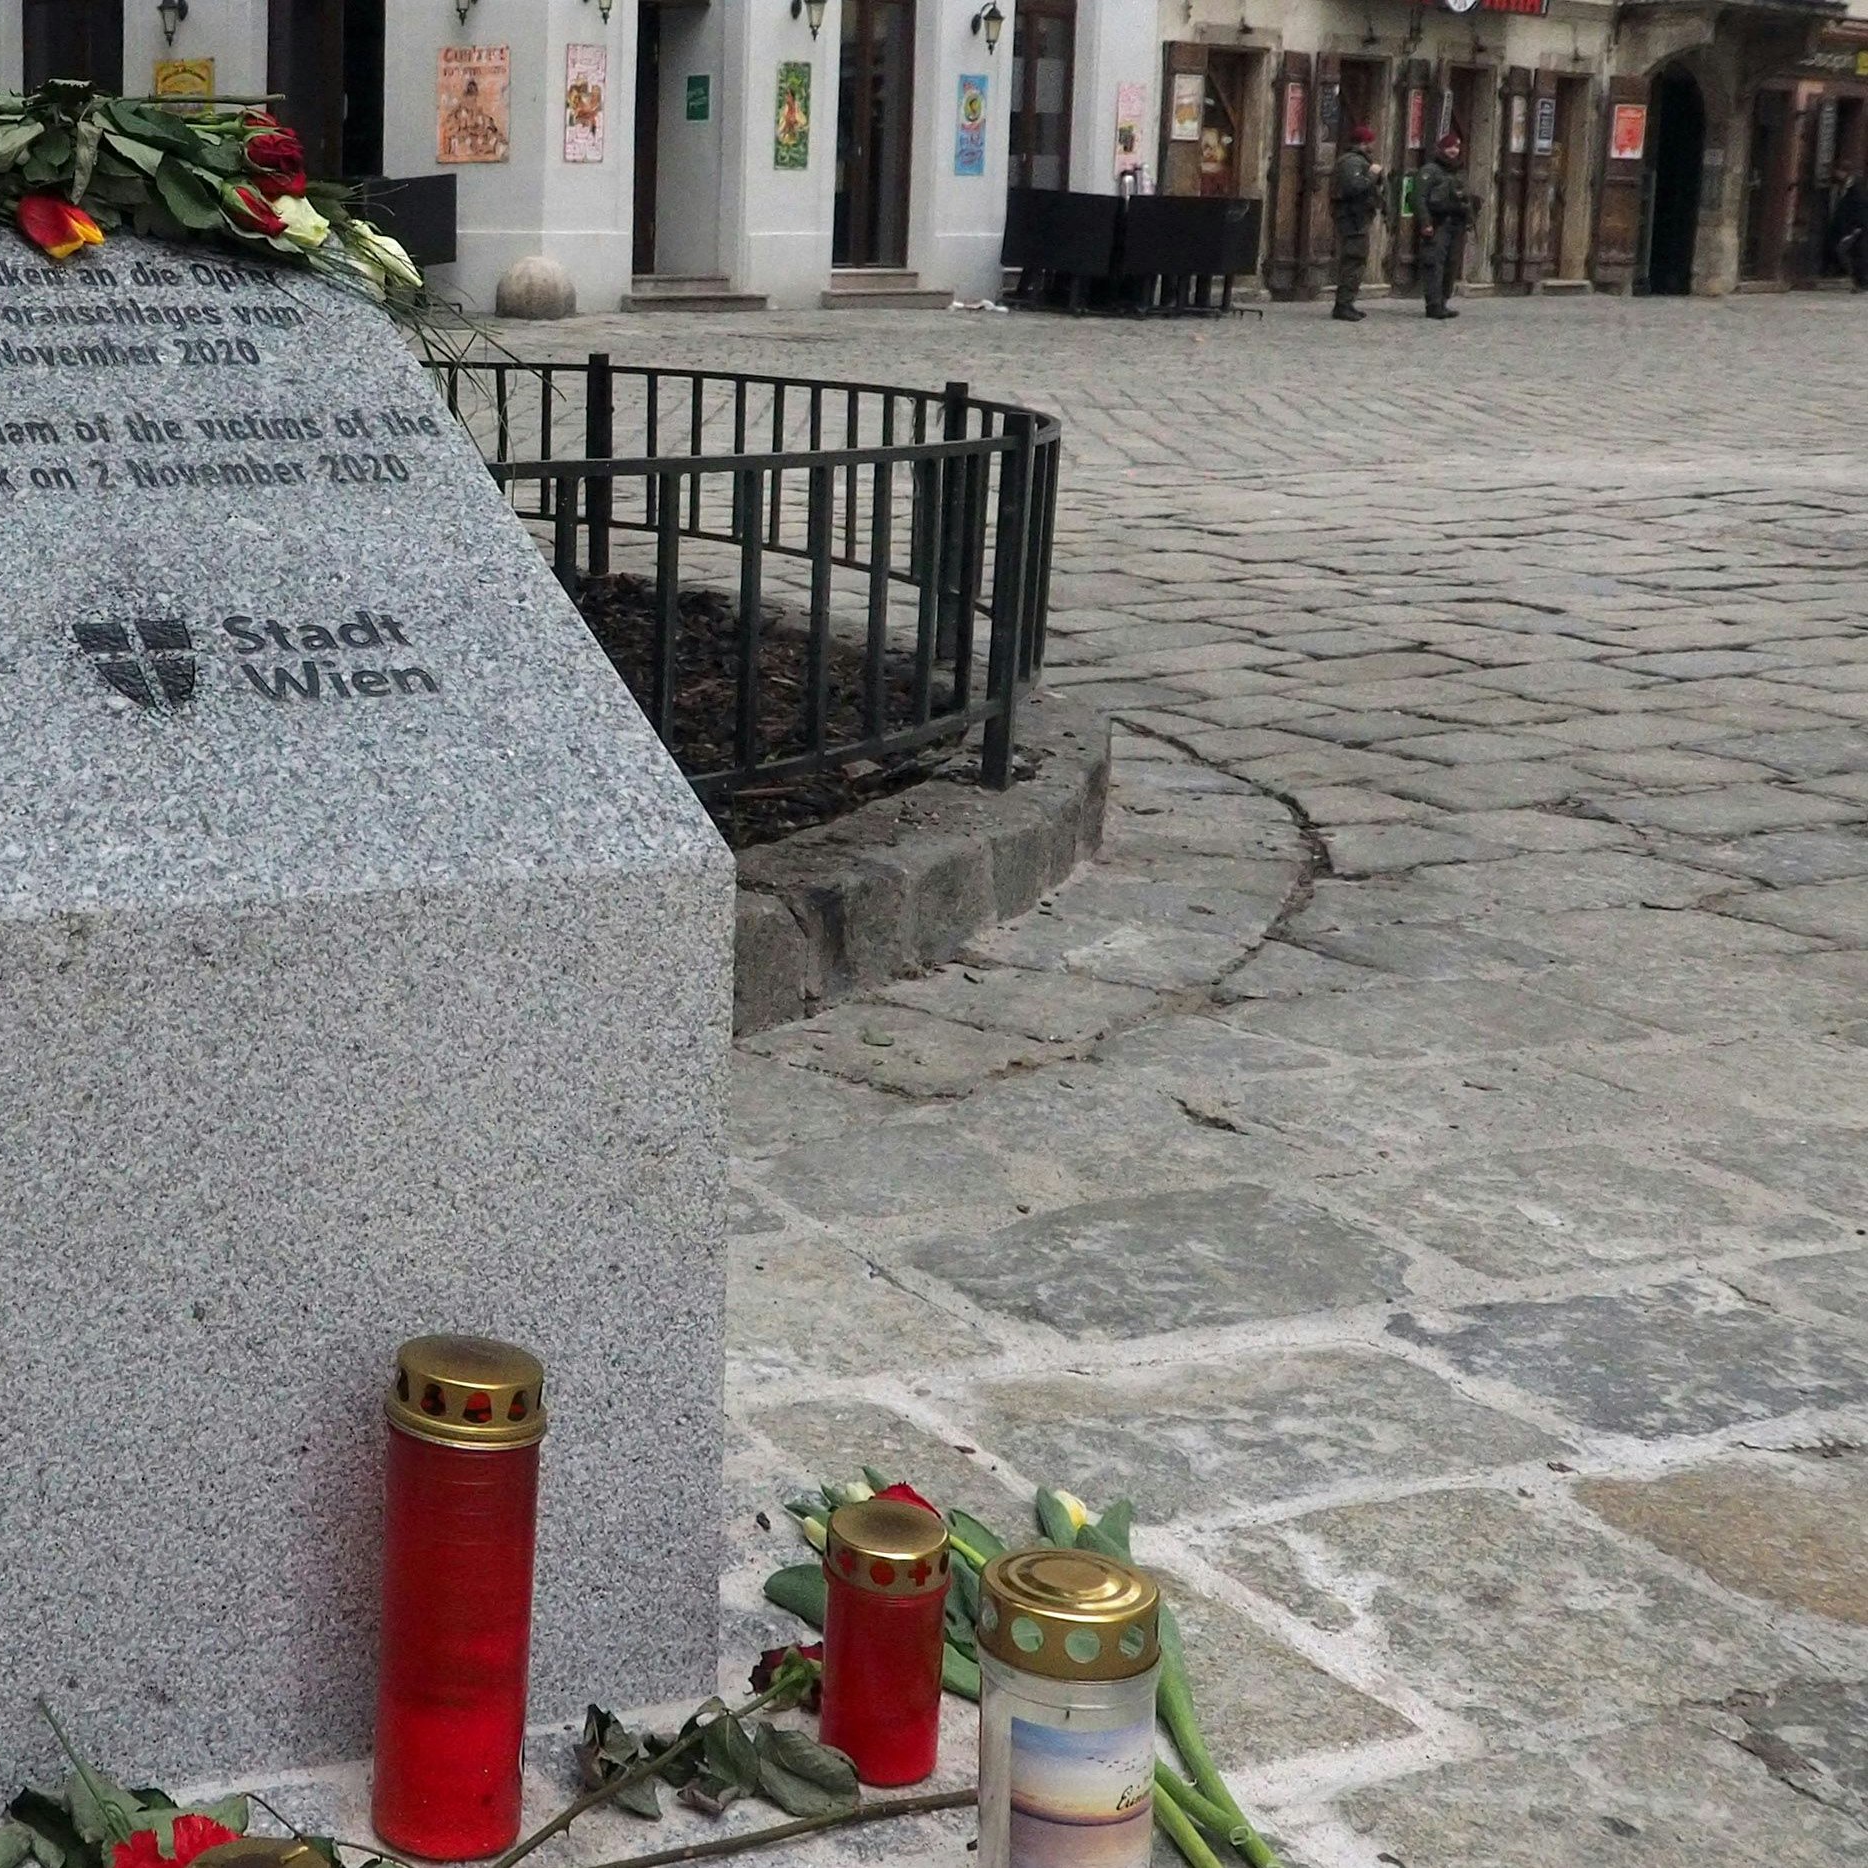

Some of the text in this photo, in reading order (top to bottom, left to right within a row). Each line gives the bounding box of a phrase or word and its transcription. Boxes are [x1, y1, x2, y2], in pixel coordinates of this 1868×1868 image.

[79, 266, 118, 287] an
[130, 260, 183, 287] die
[232, 304, 306, 329] vom
[172, 337, 261, 367] 2020
[74, 412, 111, 444] of
[124, 411, 187, 444] the
[195, 409, 325, 442] victims
[334, 409, 372, 440] of
[380, 409, 440, 438] the
[30, 466, 79, 491] on
[88, 459, 118, 490] 2
[124, 455, 308, 490] November
[319, 452, 411, 485] 2020
[222, 611, 414, 655] Stadt
[240, 660, 440, 702] Wien
